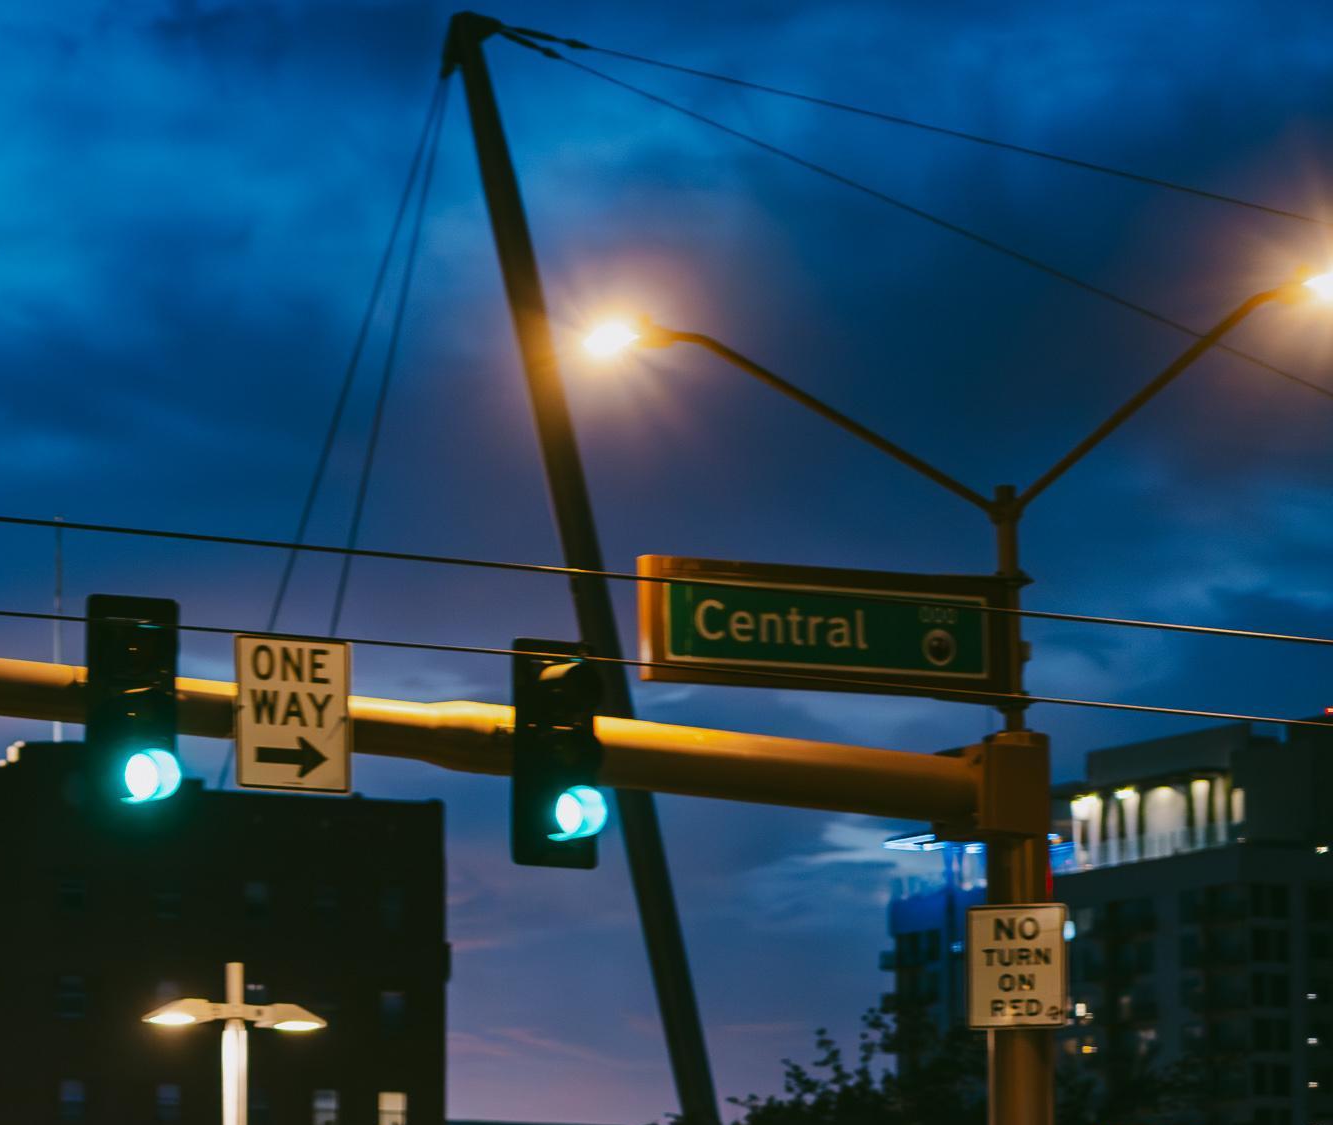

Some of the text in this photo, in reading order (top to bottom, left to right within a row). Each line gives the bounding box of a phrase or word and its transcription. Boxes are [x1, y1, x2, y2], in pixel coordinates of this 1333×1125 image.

[694, 599, 868, 650] Central
[251, 645, 331, 685] ONE
[249, 689, 334, 729] WAY
[994, 917, 1040, 941] NO
[981, 947, 1052, 967] TURN
[997, 973, 1035, 992] ON
[990, 998, 1043, 1017] RED
